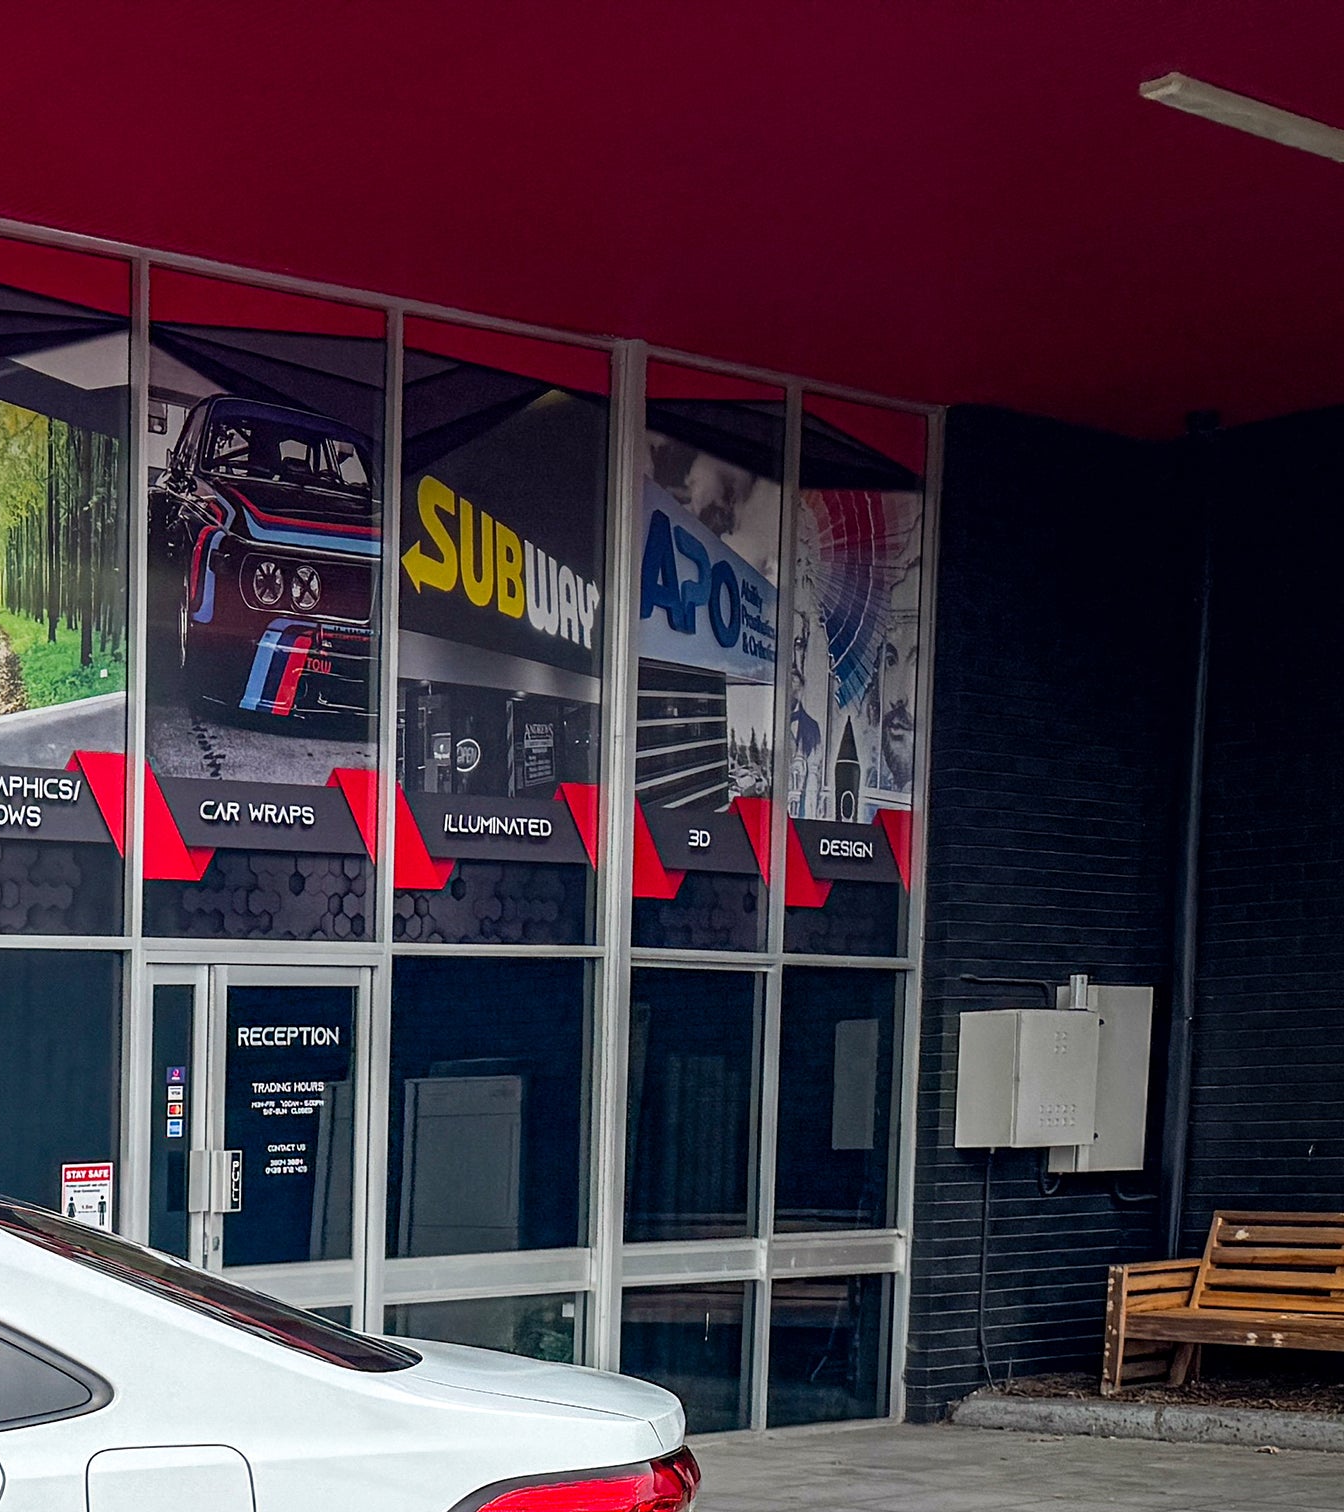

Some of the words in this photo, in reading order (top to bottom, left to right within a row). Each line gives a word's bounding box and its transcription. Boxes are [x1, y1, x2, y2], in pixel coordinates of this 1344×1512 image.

[400, 475, 600, 649] SUBWAY
[307, 658, 332, 674] TOW
[199, 800, 240, 822] CAR
[248, 803, 315, 825] WRAPS
[443, 813, 552, 837] ILLUMINATED
[688, 829, 711, 848] 3D
[820, 838, 873, 858] DESIGN
[237, 1026, 340, 1047] RECEPTION
[252, 1082, 292, 1093] TRADING
[293, 1081, 325, 1093] HOURS
[267, 1143, 296, 1153] CONTACT
[296, 1143, 307, 1152] US
[65, 1170, 87, 1180] STAY
[88, 1169, 110, 1179] SAFE
[231, 1160, 240, 1202] PULL
